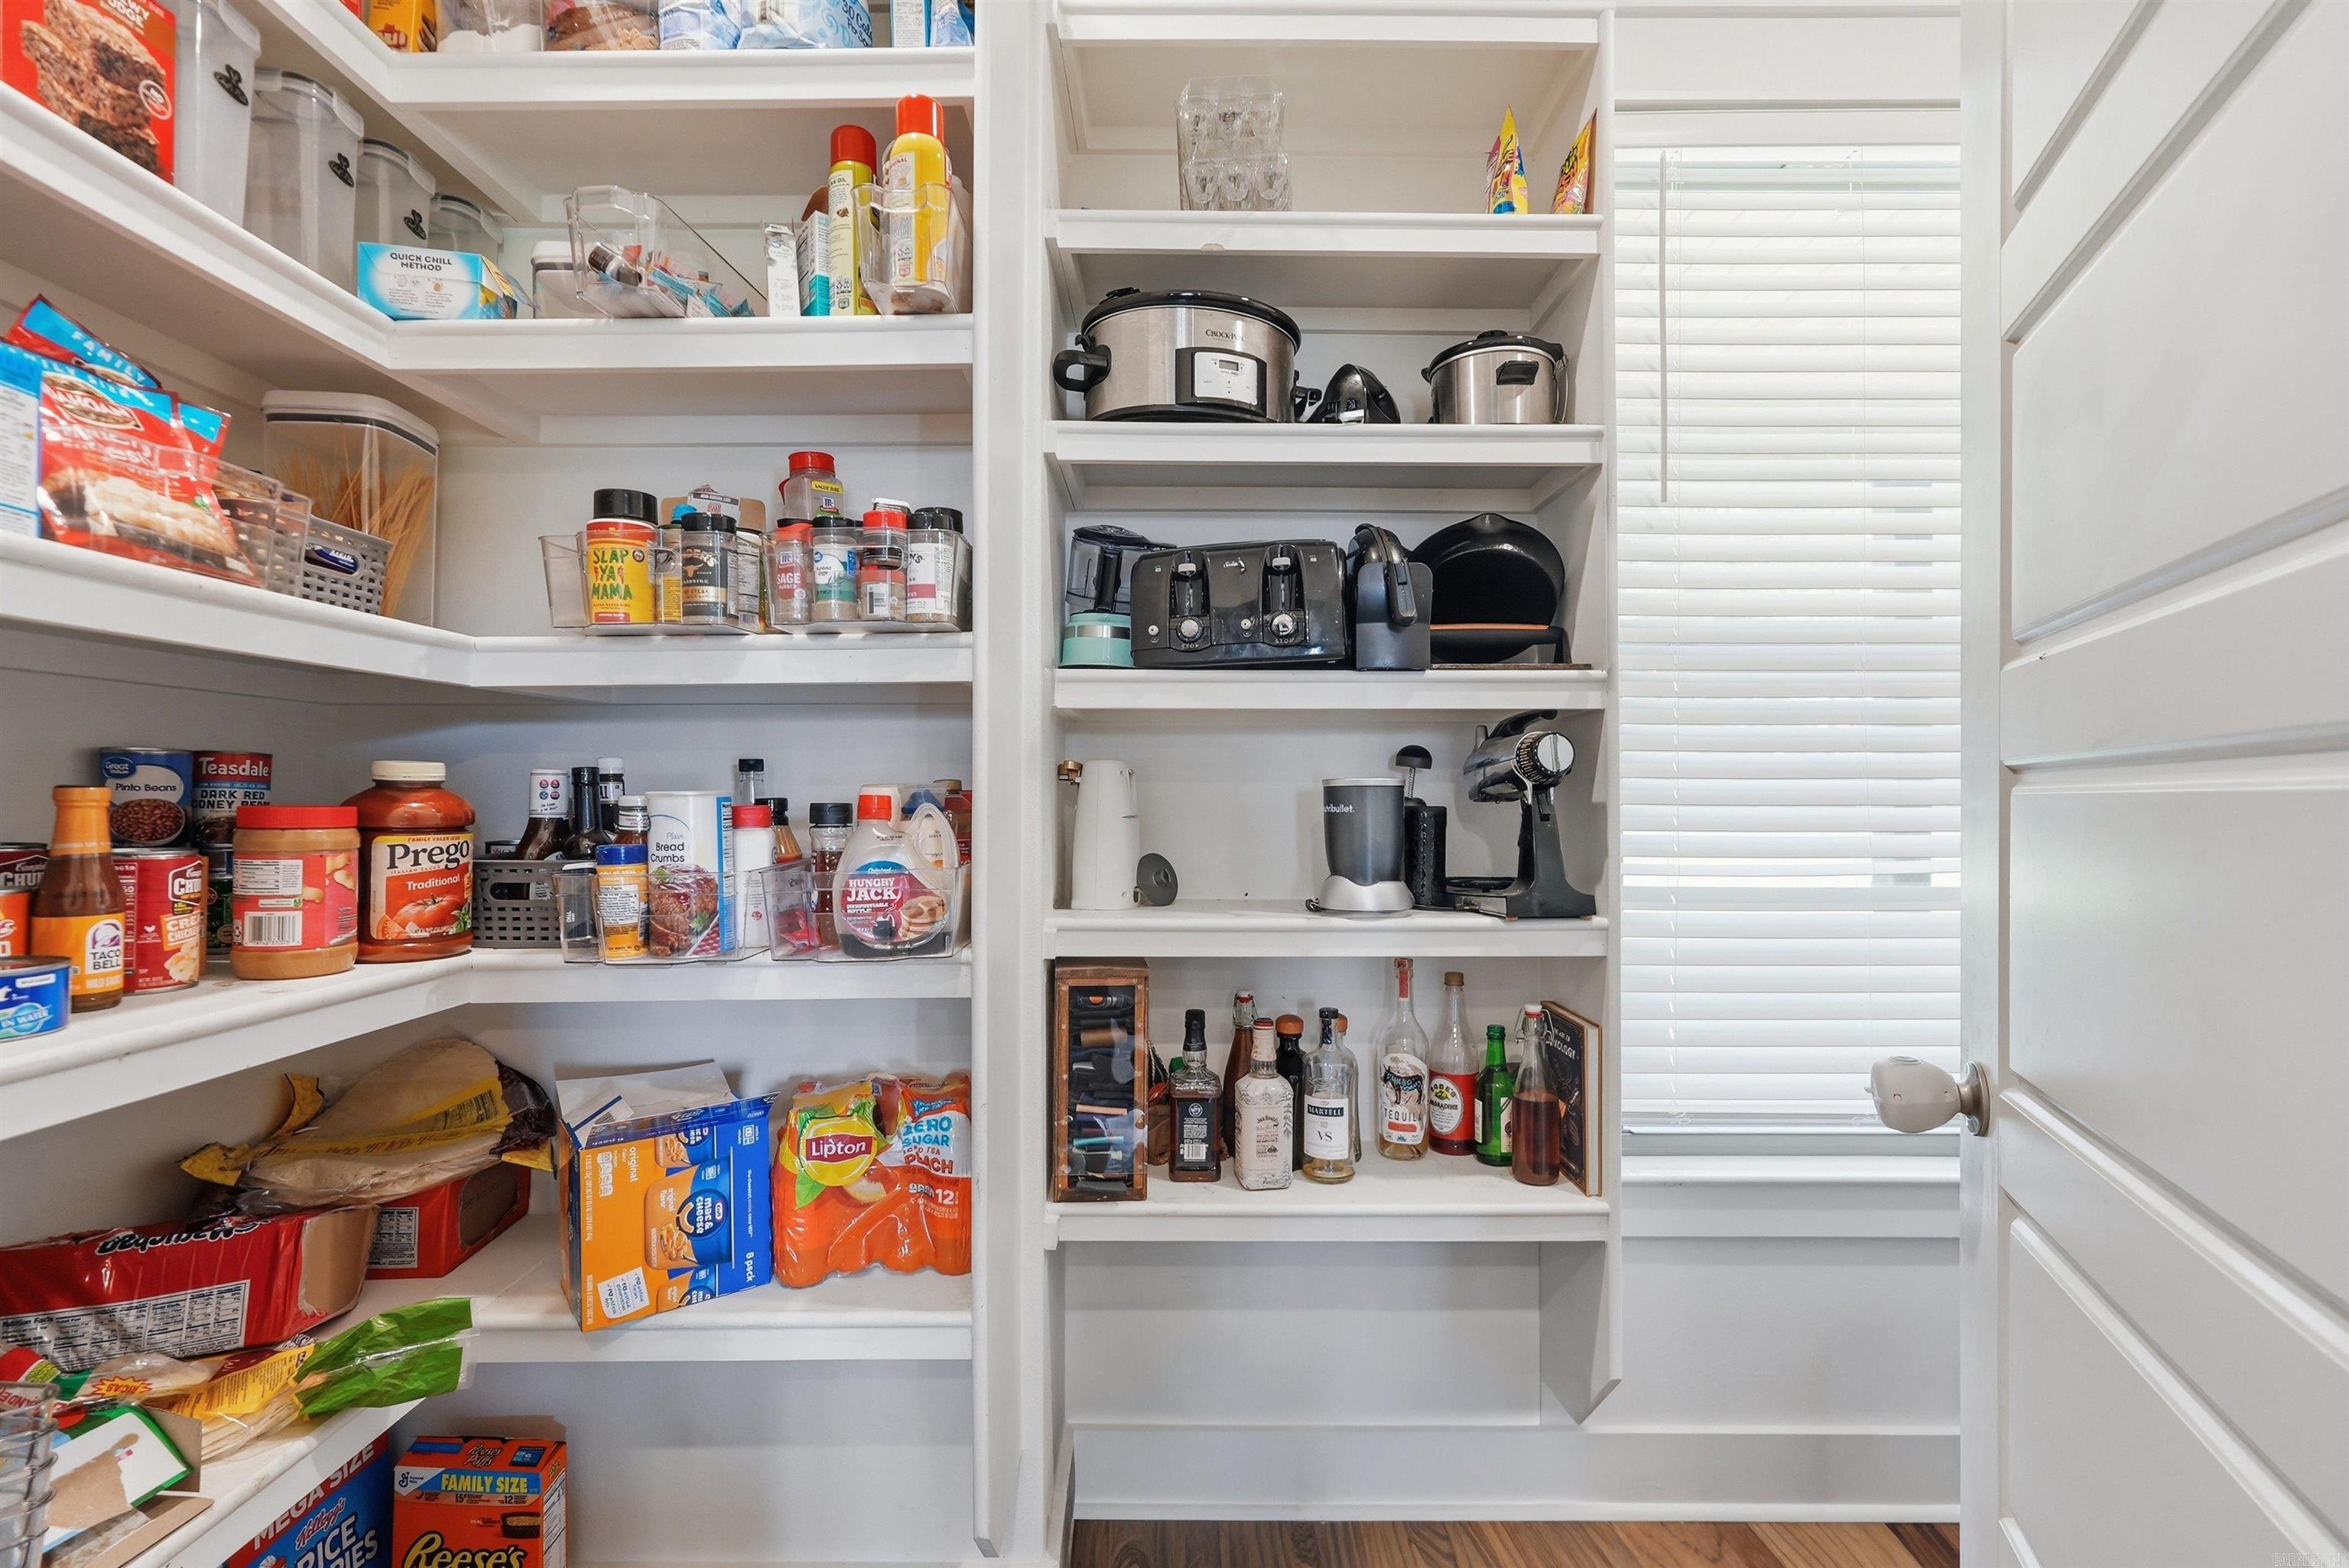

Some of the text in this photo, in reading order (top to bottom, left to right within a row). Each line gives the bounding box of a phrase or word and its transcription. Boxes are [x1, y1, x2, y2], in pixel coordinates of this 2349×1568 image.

[390, 252, 452, 265] QUICK CHILL
[401, 262, 442, 271] METHOD
[593, 549, 629, 565] SLAP
[600, 565, 616, 583] YA
[777, 573, 801, 585] SAGE
[592, 584, 633, 601] MAMA
[199, 756, 270, 777] Teasdale
[115, 783, 177, 792] Pinto Beans
[200, 789, 265, 800] DARK RED
[666, 832, 684, 840] Plain
[386, 839, 469, 870] Prego
[655, 842, 685, 852] Bread
[650, 853, 685, 863] Crumbs
[406, 873, 460, 891] Traditional
[848, 877, 895, 888] HUNGRY
[846, 887, 898, 902] JACK
[90, 948, 122, 961] TACO
[93, 959, 122, 970] BELL
[1308, 1105, 1343, 1116] MARTELL
[1384, 1108, 1422, 1123] TEQUILA
[903, 1115, 952, 1137] ZERO
[902, 1134, 950, 1148] SUGAR
[1317, 1130, 1333, 1142] VS
[811, 1139, 866, 1158] Lipton
[627, 1146, 639, 1183] original
[667, 1187, 676, 1213] original
[935, 1188, 955, 1206] 12
[703, 1196, 712, 1222] mac
[743, 1260, 755, 1283] pack
[106, 1381, 141, 1394] RICAS
[330, 1444, 374, 1488] SIZE
[441, 1473, 528, 1493] FAMILY SIZE
[504, 1495, 513, 1504] 12
[295, 1497, 346, 1550] Kellogg's
[403, 1531, 526, 1568] Reese's
